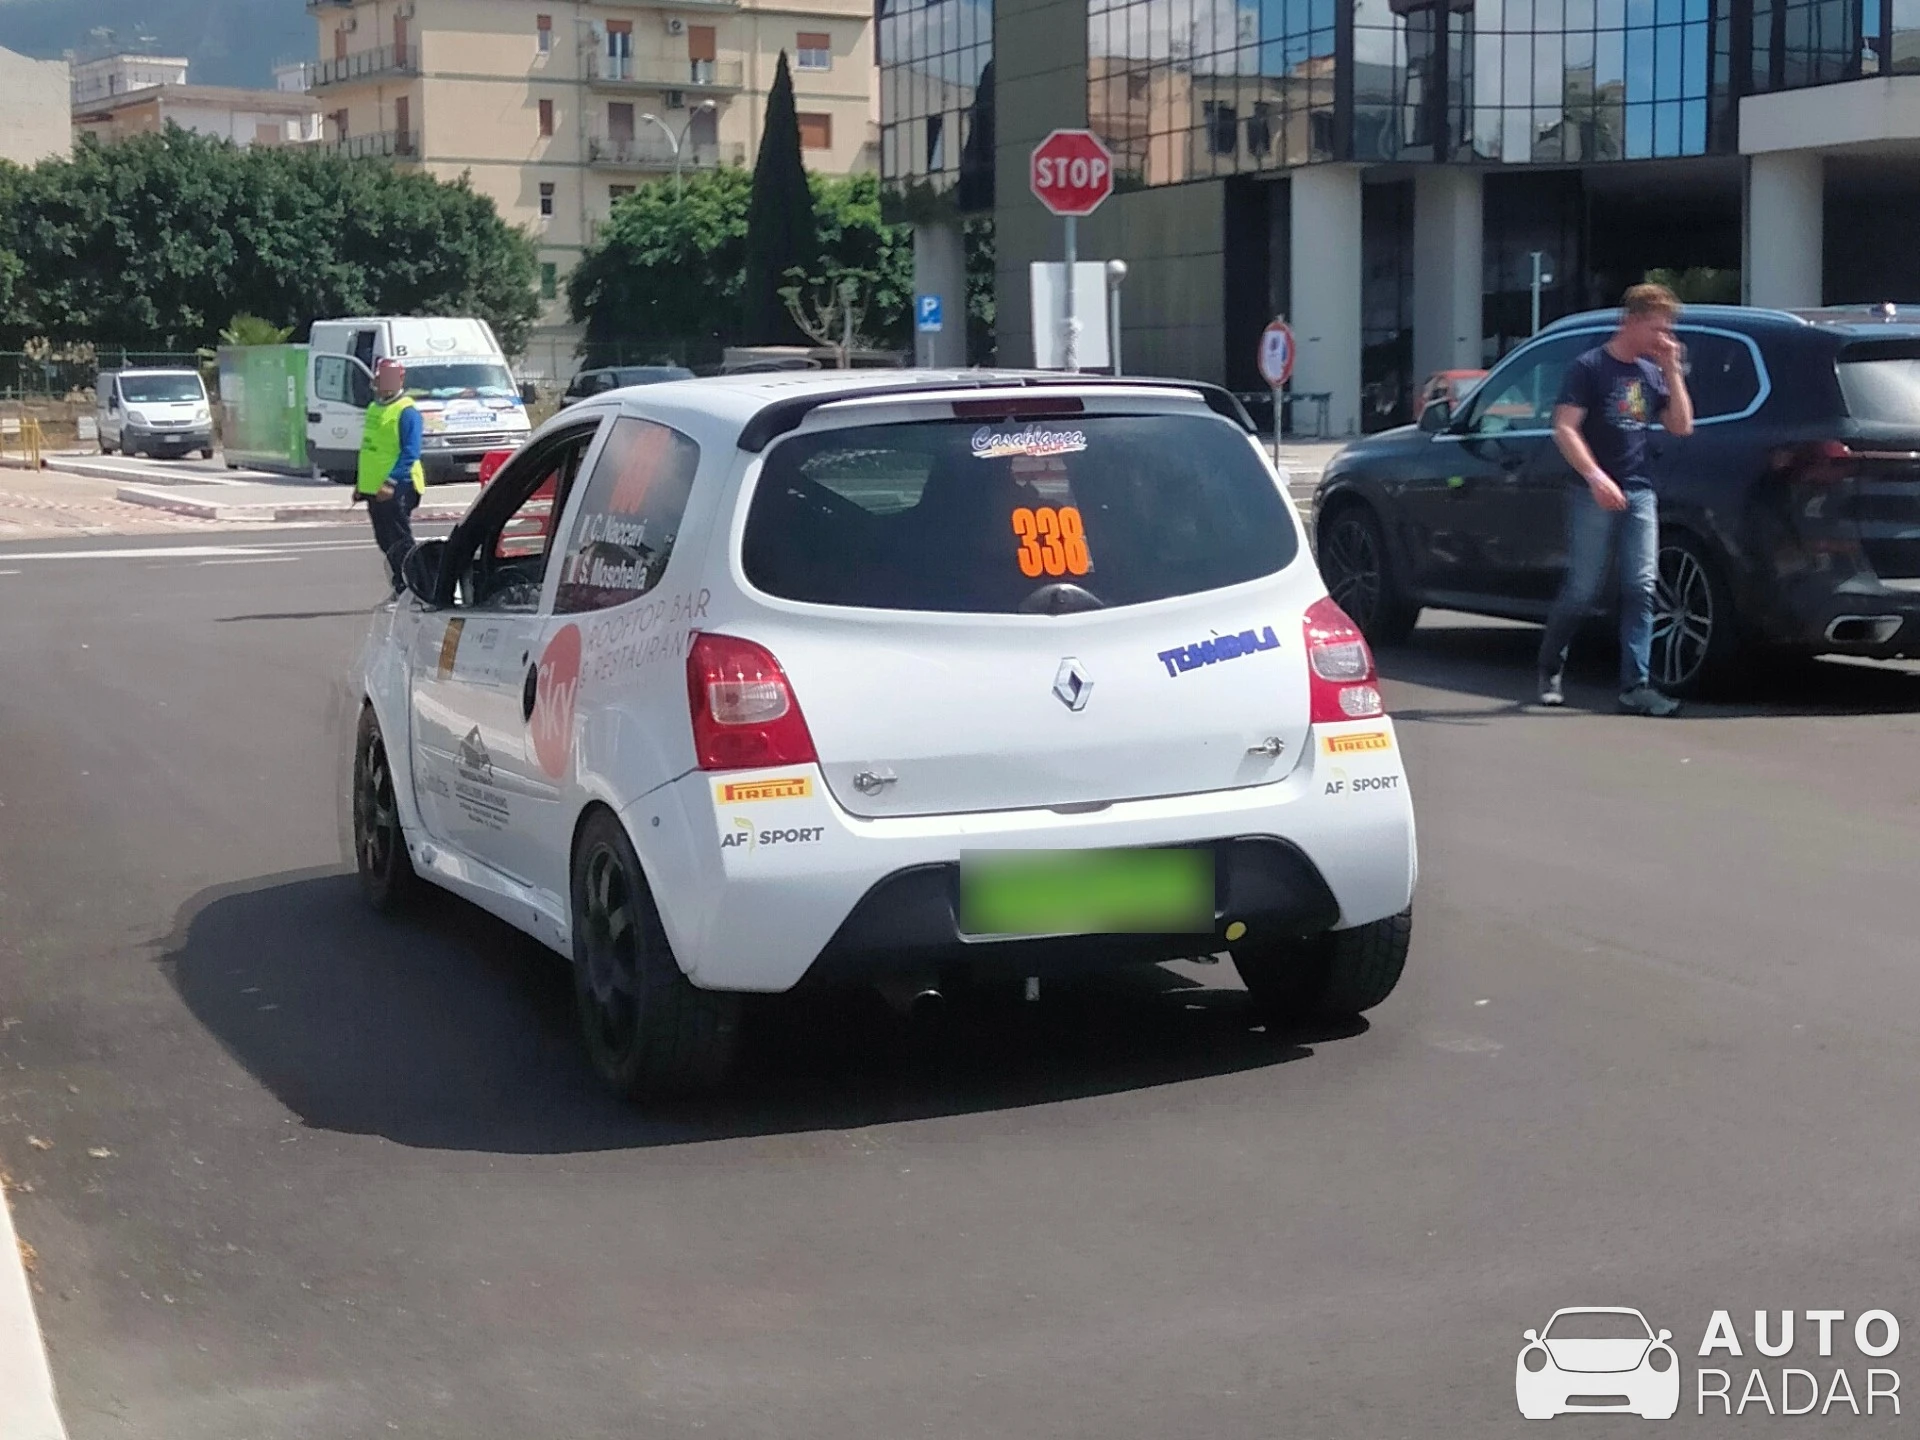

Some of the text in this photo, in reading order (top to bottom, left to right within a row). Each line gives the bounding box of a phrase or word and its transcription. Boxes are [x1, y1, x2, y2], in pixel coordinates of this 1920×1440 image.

[1036, 157, 1107, 188] STOP
[922, 297, 938, 317] P
[396, 345, 408, 356] B
[1012, 506, 1089, 577] 338
[669, 588, 711, 623] BAR
[537, 661, 577, 751] Sky
[1328, 733, 1387, 752] PIRELLI
[725, 779, 804, 801] PIRELLI
[1324, 776, 1399, 795] AF SPORT
[721, 827, 824, 848] AF SPORT
